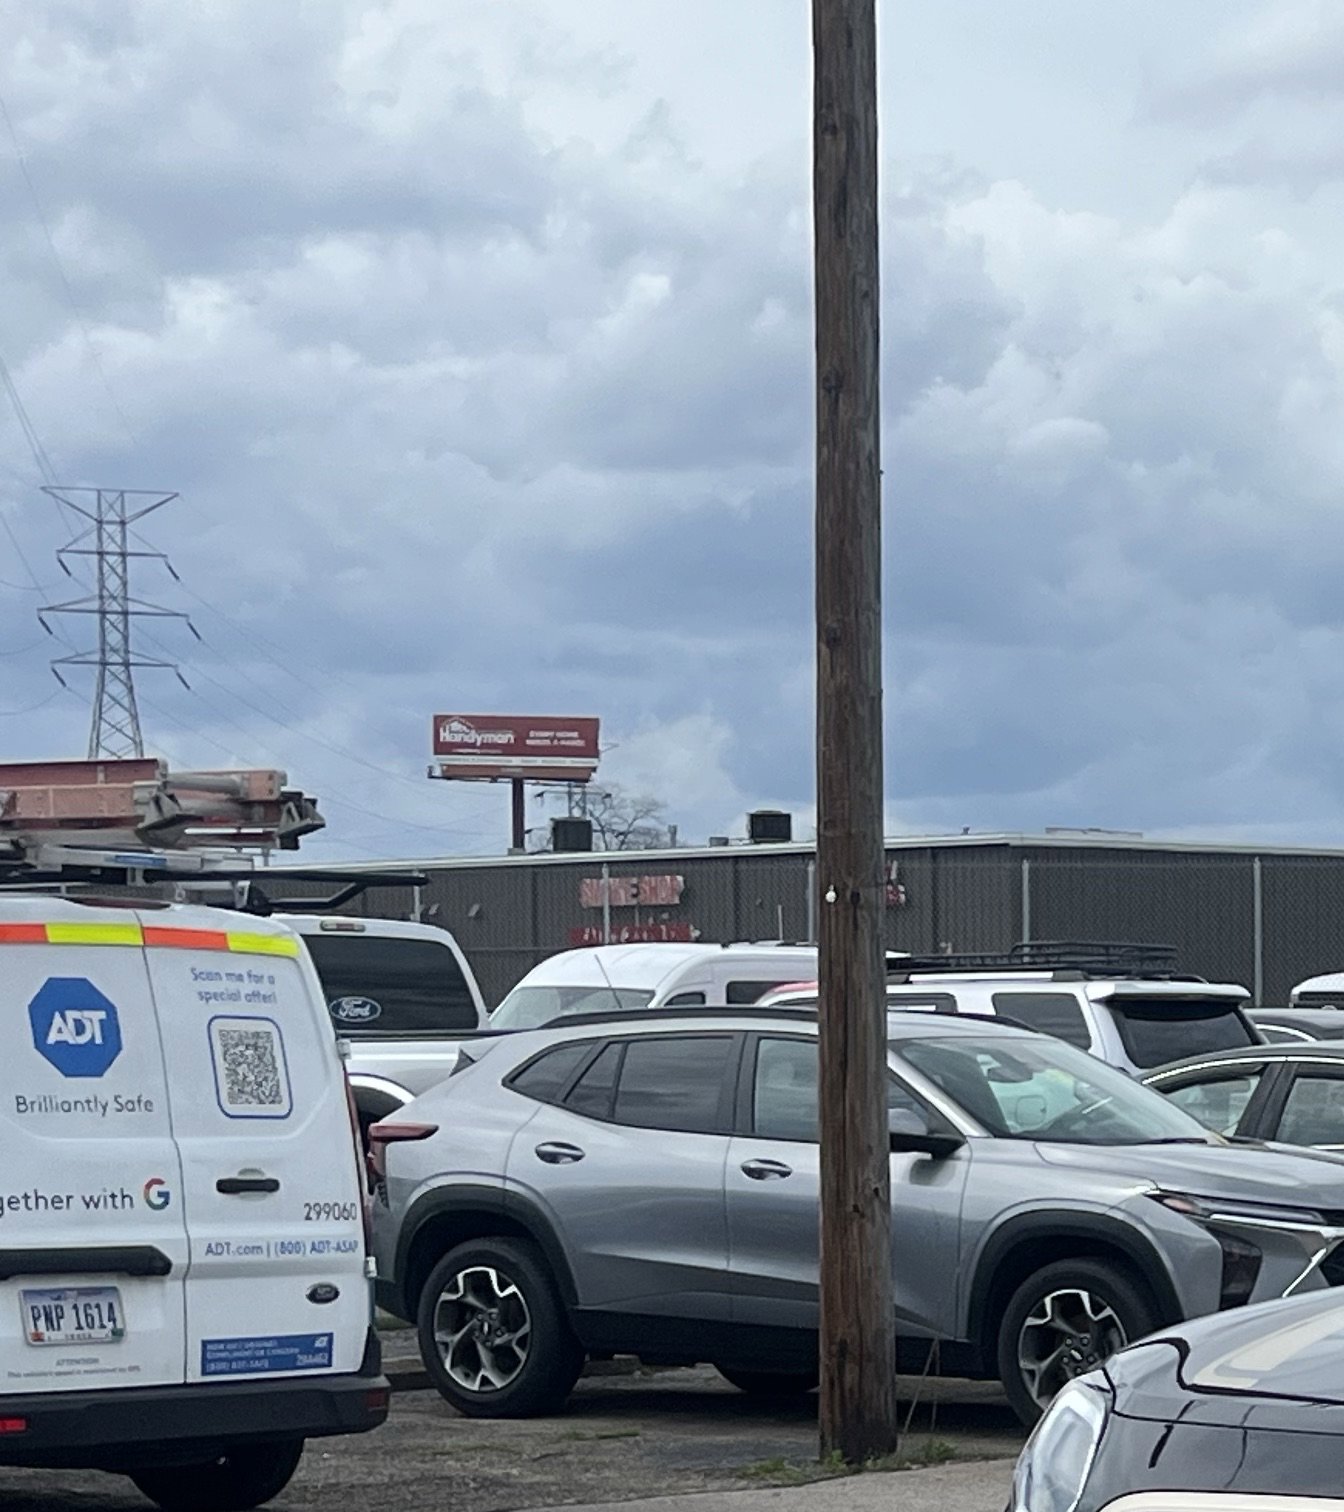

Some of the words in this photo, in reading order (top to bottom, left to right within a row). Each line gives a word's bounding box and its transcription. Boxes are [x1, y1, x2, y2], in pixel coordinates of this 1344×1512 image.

[440, 724, 515, 747] Handyman
[190, 967, 222, 982] Scan
[225, 972, 244, 983] me
[247, 969, 264, 984] for
[267, 975, 276, 985] a
[197, 988, 241, 1004] special
[46, 1009, 107, 1045] ADT
[15, 1094, 109, 1117] Brilliantly
[113, 1093, 154, 1113] Safe
[81, 1186, 135, 1210] with
[143, 1177, 171, 1211] G
[304, 1202, 358, 1221] 299060
[205, 1241, 264, 1256] ADT.com
[274, 1240, 307, 1257] (800)
[30, 1303, 65, 1332] PNP
[71, 1301, 119, 1331] 1614
